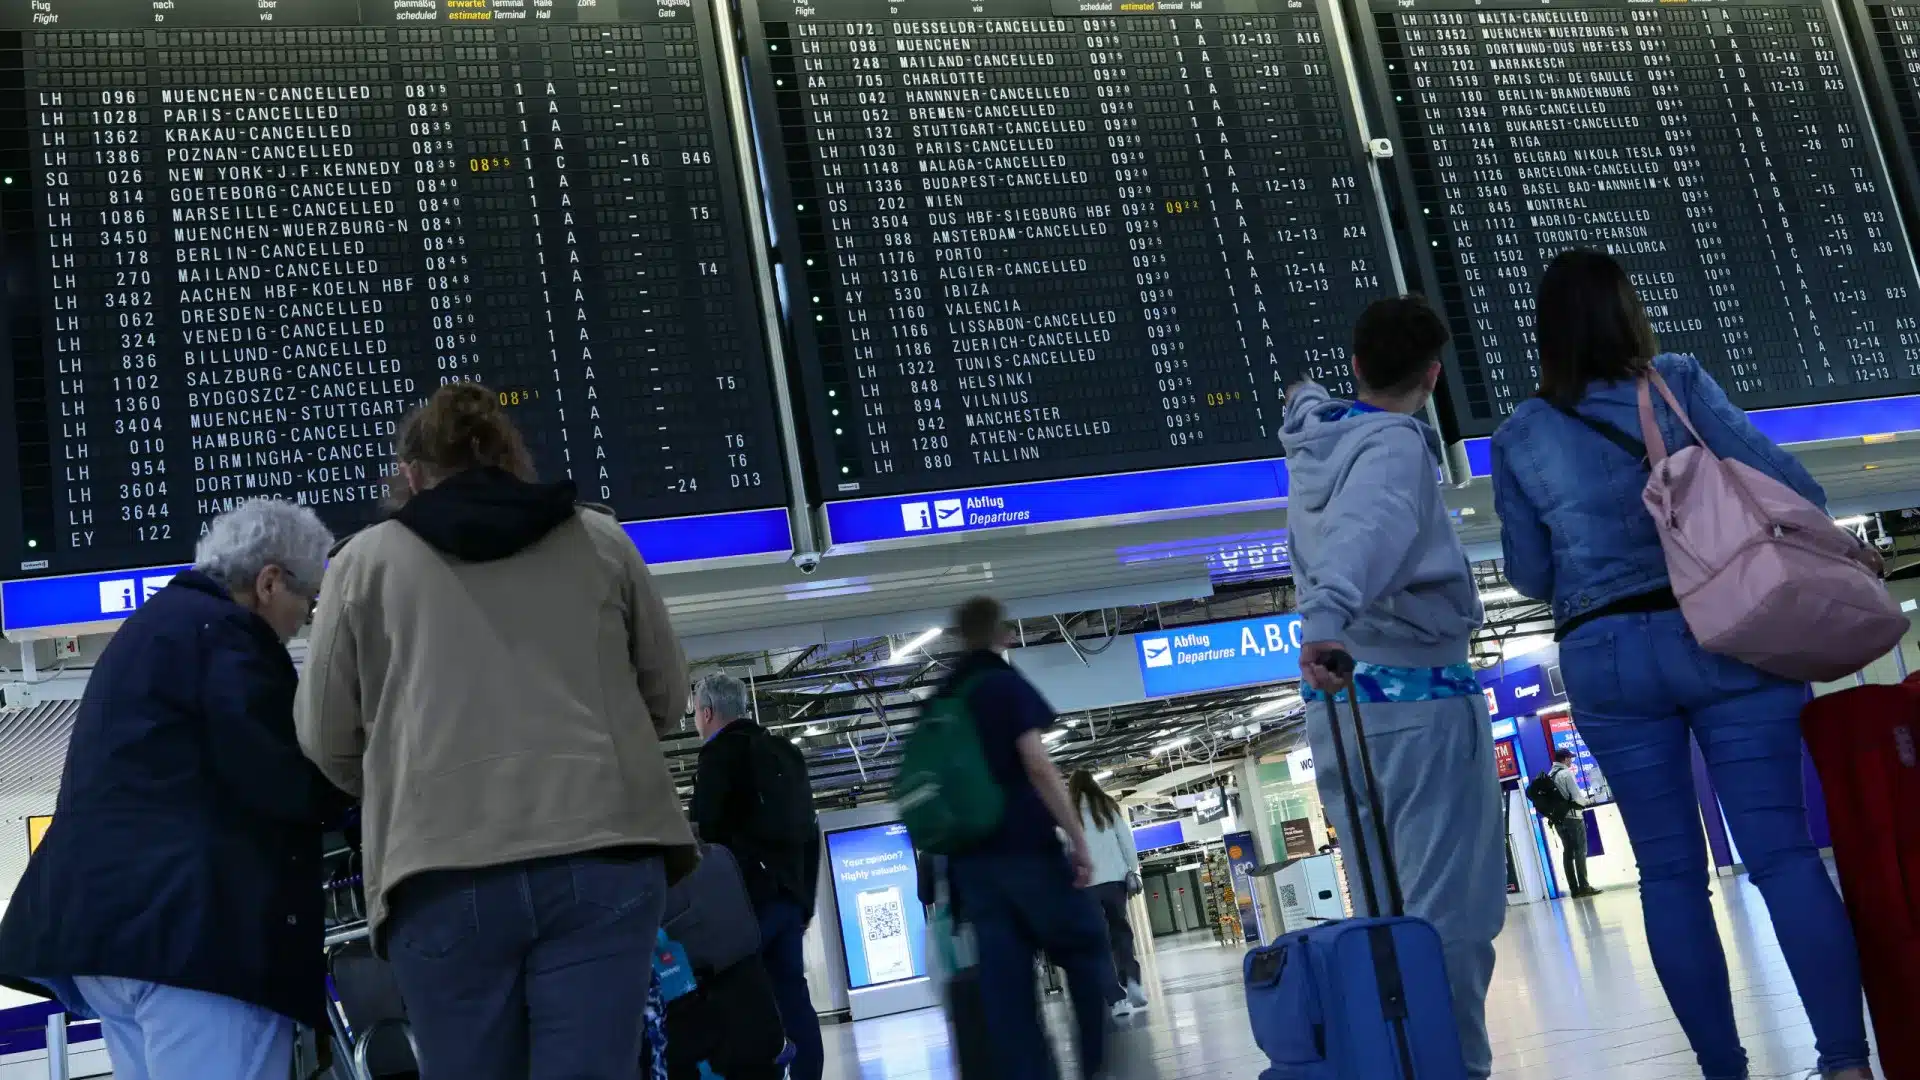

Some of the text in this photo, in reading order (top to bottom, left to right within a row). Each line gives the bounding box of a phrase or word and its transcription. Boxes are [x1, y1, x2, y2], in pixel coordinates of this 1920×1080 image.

[32, 0, 50, 10] Flug
[153, 0, 174, 9] nach
[795, 7, 815, 16] Flight
[33, 9, 676, 24] Flight to via scheduled estimated Terminal Hall Gate
[1433, 11, 1588, 24] 1310 MALTA-CANCELLED
[893, 20, 1065, 34] DUESSELDR-CANCELLED
[1482, 26, 1628, 38] MUENCHEN-WUERZBURG-N
[849, 32, 1320, 52] 098 MUENCHEN A16
[1485, 40, 1632, 54] DORTMUND-DUS HBF-ESS
[899, 53, 1053, 67] MAILAND-CANCELLED
[1452, 50, 1833, 70] 202 MARRAKESCH B27
[808, 64, 1319, 87] AA 705 CHARLOTTE D1
[1493, 70, 1633, 84] PARIS CH. DE GAULLE
[102, 86, 369, 104] 096 MUENCHEN-CANCELLED
[1498, 79, 1844, 100] BERLIN-BRANDENBURG A25
[164, 106, 337, 122] PARIS-CANCELLED
[909, 104, 1055, 119] BREMEN-CANCELLED
[1501, 102, 1605, 116] PRAG-CANCELLED
[166, 124, 351, 141] KRAKAU-CANCELLED
[913, 120, 1085, 137] STUTTGART-CANCELLED
[1506, 116, 1638, 131] BUKAREST-CANCELLED
[860, 138, 1053, 156] 1030 PARIS-CANCELLED
[1432, 136, 1540, 150] BT 244 RIGA
[167, 144, 352, 161] POZNAN-CANCELLED
[1514, 146, 1662, 163] BELGRAD NIKOLA TESLA
[46, 151, 710, 186] SQ 026 NEW YORK-J.F.KENNEDY B46
[919, 155, 1065, 171] MALAGA-CANCELLED
[1518, 162, 1658, 179] BARCELONA-CANCELLED
[922, 171, 1087, 189] BUDAPEST-CANCELLED
[1522, 177, 1670, 195] BASEL BAD-MANNHEIM-K
[171, 181, 391, 201] GOETEBORG-CANCELLED
[829, 176, 1354, 212] OS WIEN 12-13 A18
[1450, 182, 1874, 215] AC 845 MONTREAL B45
[172, 200, 393, 221] MARSEILLE-CANCELLED
[929, 205, 1110, 225] DUS HBF-SIEGBURG HBF
[1530, 209, 1649, 226] MADRID-CANCELLED
[175, 207, 708, 241] MUENCHEN-WUERZBURG-N T5
[1535, 211, 1883, 242] TORONTO-PEARSON B23
[884, 222, 1106, 245] 988 AMSTERDAM-CANCELLED
[116, 240, 364, 264] 178 BERLIN-CANCELLED
[935, 226, 1366, 261] PORTO A24
[1606, 240, 1666, 254] MALLORCA
[1498, 241, 1892, 277] 4409 A30
[178, 260, 377, 282] MAILAND-CANCELLED
[940, 259, 1086, 279] ALGIER-CANCELLED
[180, 278, 412, 303] AACHEN HBF-KOELN HBF
[846, 283, 989, 303] 4Y 530 IBIZA
[1509, 282, 1531, 294] 012
[181, 299, 381, 323] DRESDEN-CANCELLED
[945, 299, 1020, 315] VALENCIA
[949, 310, 1116, 333] LISSABON-CANCELLED
[58, 319, 384, 351] LH 324 VENEDIG-CANCELLED
[896, 329, 1110, 356] 1186 ZUERICH-CANCELLED
[185, 339, 386, 365] BILLUND-CANCELLED
[956, 348, 1095, 370] TUNIS-CANCELLED
[187, 359, 400, 386] SALZBURG-CANCELLED
[959, 372, 1032, 389] HELSINKI
[189, 379, 414, 407] BYDGOSZCZ-CANCELLED
[962, 390, 1028, 408] VILNIUS
[917, 407, 1060, 430] 942 MANCHESTER
[130, 421, 395, 454] 010 HAMBURG-CANCELLED
[970, 421, 1110, 445] ATHEN-CANCELLED
[195, 442, 397, 470] BIRMINGHA-CANCELL
[924, 446, 1039, 468] 880 TALLINN
[196, 465, 365, 492] DORTMUND-KOELN
[71, 472, 760, 547] EY 122 D13
[121, 503, 168, 520] 3644
[967, 496, 1004, 509] Abflug
[970, 510, 1030, 526] Departures
[1174, 634, 1210, 648] Abflug
[1178, 648, 1236, 665] Departures
[1495, 744, 1508, 758] TM
[843, 850, 903, 868] Your opinion?
[841, 869, 869, 882] Highly
